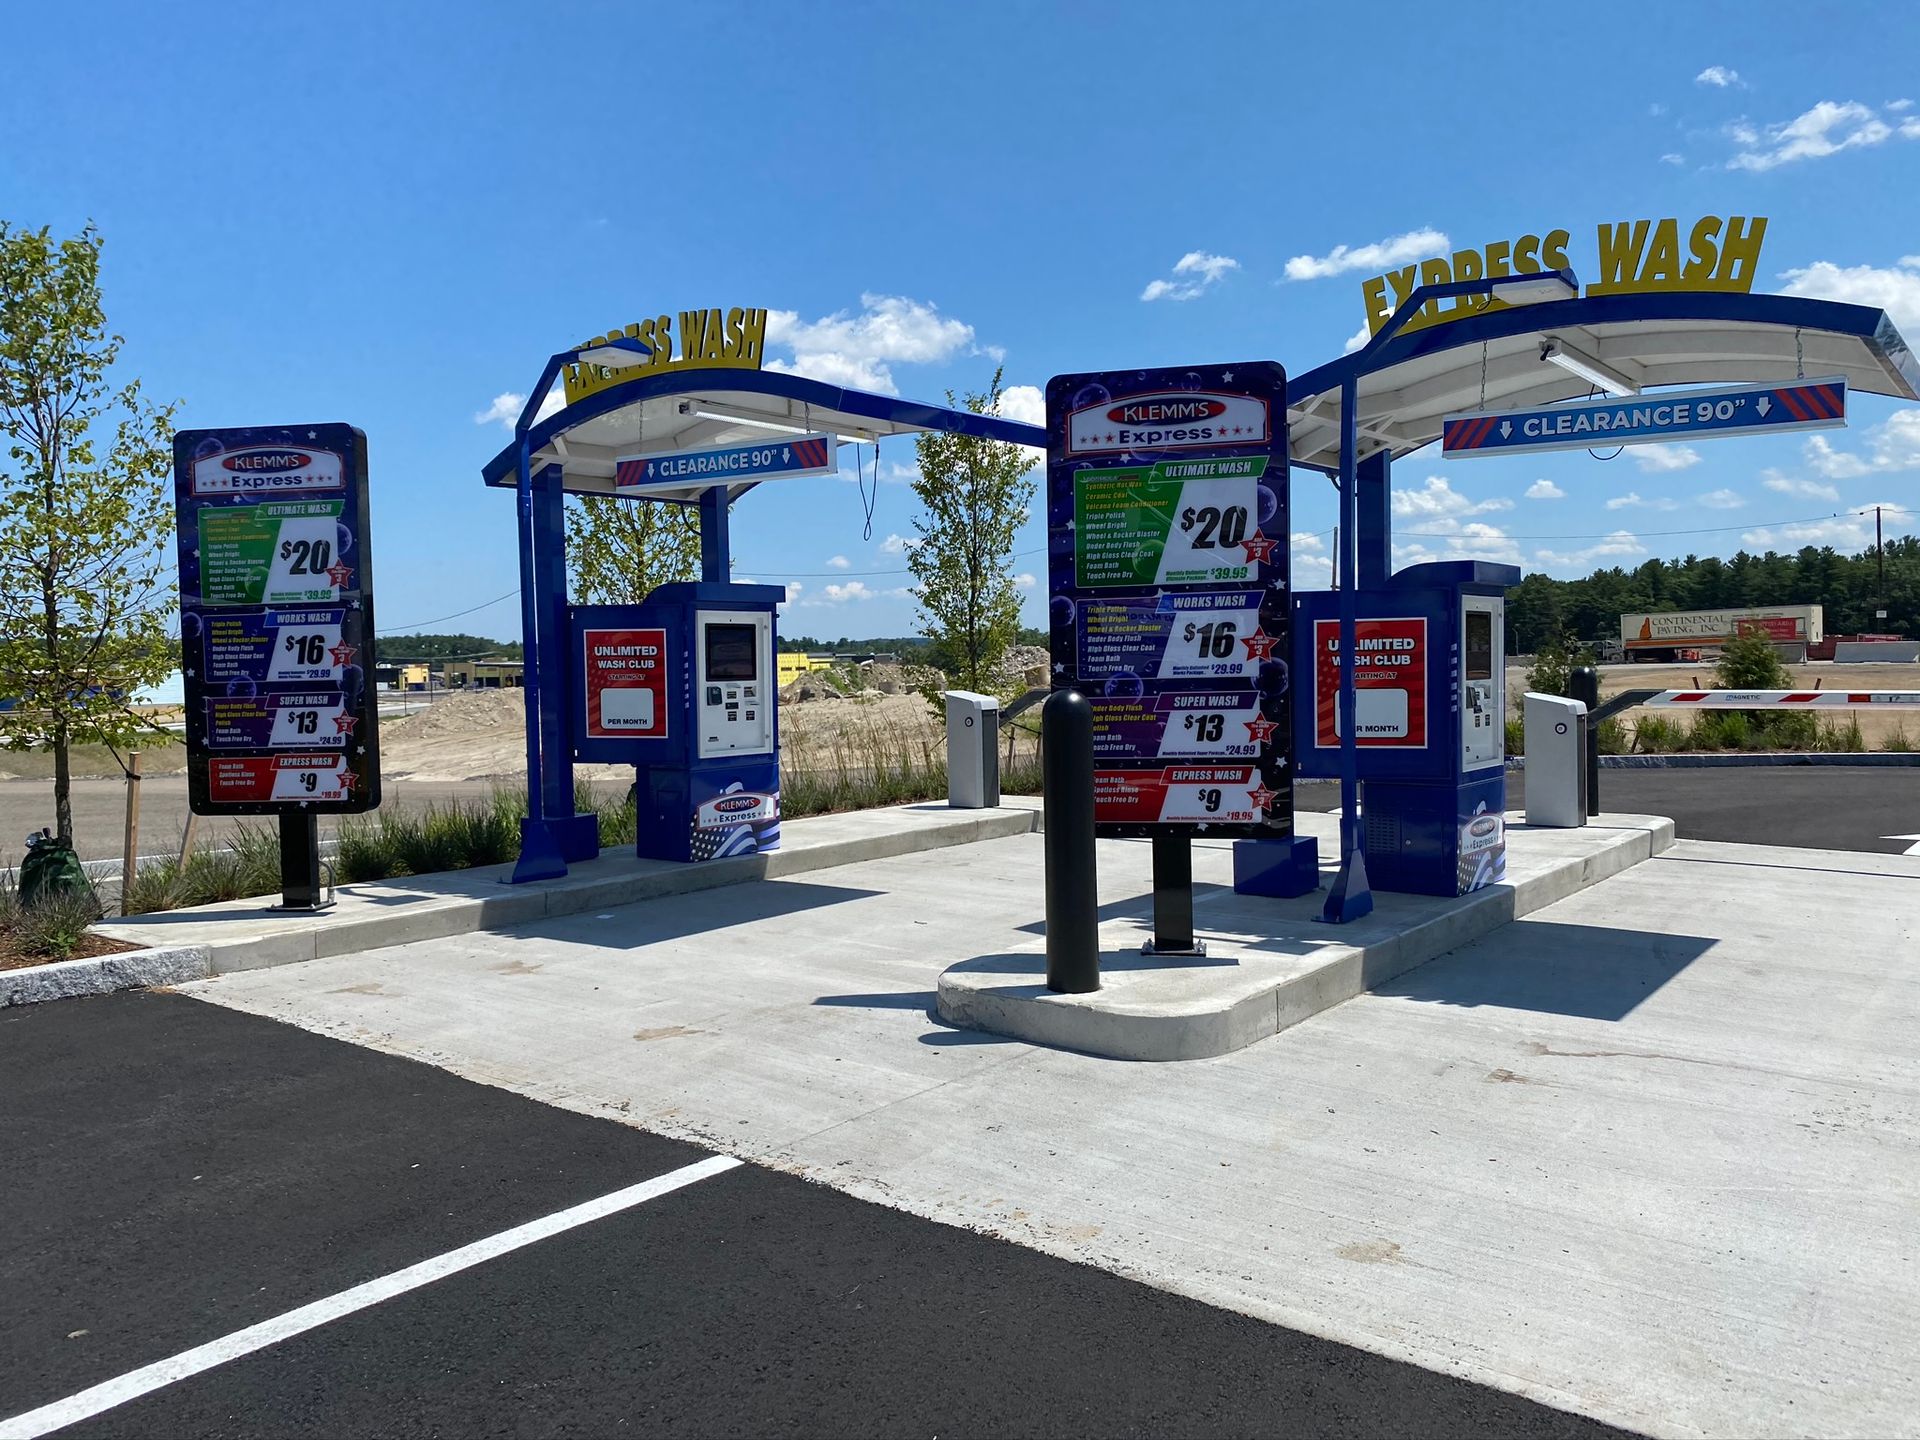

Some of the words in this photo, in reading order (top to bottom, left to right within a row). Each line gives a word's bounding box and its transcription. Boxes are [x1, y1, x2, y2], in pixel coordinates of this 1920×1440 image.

[1596, 215, 1768, 288] WASH
[678, 307, 767, 364] WASH
[1124, 402, 1209, 422] KLEMM'S
[1524, 404, 1690, 437] CLEARANCE
[1120, 428, 1213, 444] Express
[235, 454, 299, 470] KLEMM'S
[660, 453, 749, 477] CLEARANCE
[1165, 464, 1215, 478] ULTIMATE
[1218, 462, 1251, 475] WASH
[232, 475, 302, 488] Express
[267, 505, 305, 516] ULTIMATE
[307, 504, 332, 513] WASH
[1181, 506, 1247, 550] $20
[281, 540, 330, 575] $20
[1210, 566, 1248, 580] $39.99
[1174, 597, 1212, 608] WORKS
[1214, 595, 1246, 607] WASH
[277, 614, 306, 623] WORKS
[308, 613, 332, 622] WASH
[1652, 615, 1728, 627] CONTINENTAL
[1184, 622, 1237, 658] $16
[1328, 638, 1415, 650] UIMITED
[285, 634, 325, 665] $16
[594, 646, 658, 656] UNLIMITED
[598, 660, 625, 669] WASH
[628, 660, 655, 669] CLUB
[1332, 656, 1370, 666] WSH
[1374, 655, 1411, 665] CLUB
[307, 669, 331, 678] $29.99
[1212, 664, 1243, 674] $29.99
[1356, 672, 1384, 680] ARTING
[280, 697, 305, 705] SUPER
[306, 696, 329, 704] WASH
[1174, 697, 1206, 707] SUPER
[1209, 696, 1239, 706] WASH
[288, 711, 318, 734] $13
[1184, 714, 1225, 742] $13
[1226, 745, 1256, 756] $24.99
[280, 758, 310, 766] EXPRESS
[312, 757, 333, 766] WASH
[1172, 771, 1212, 780] EXPRESS
[1214, 770, 1242, 780] WASH
[300, 773, 318, 792] $9
[1198, 789, 1222, 812] $9
[720, 812, 756, 823] Express
[1227, 812, 1254, 821] $19.99
